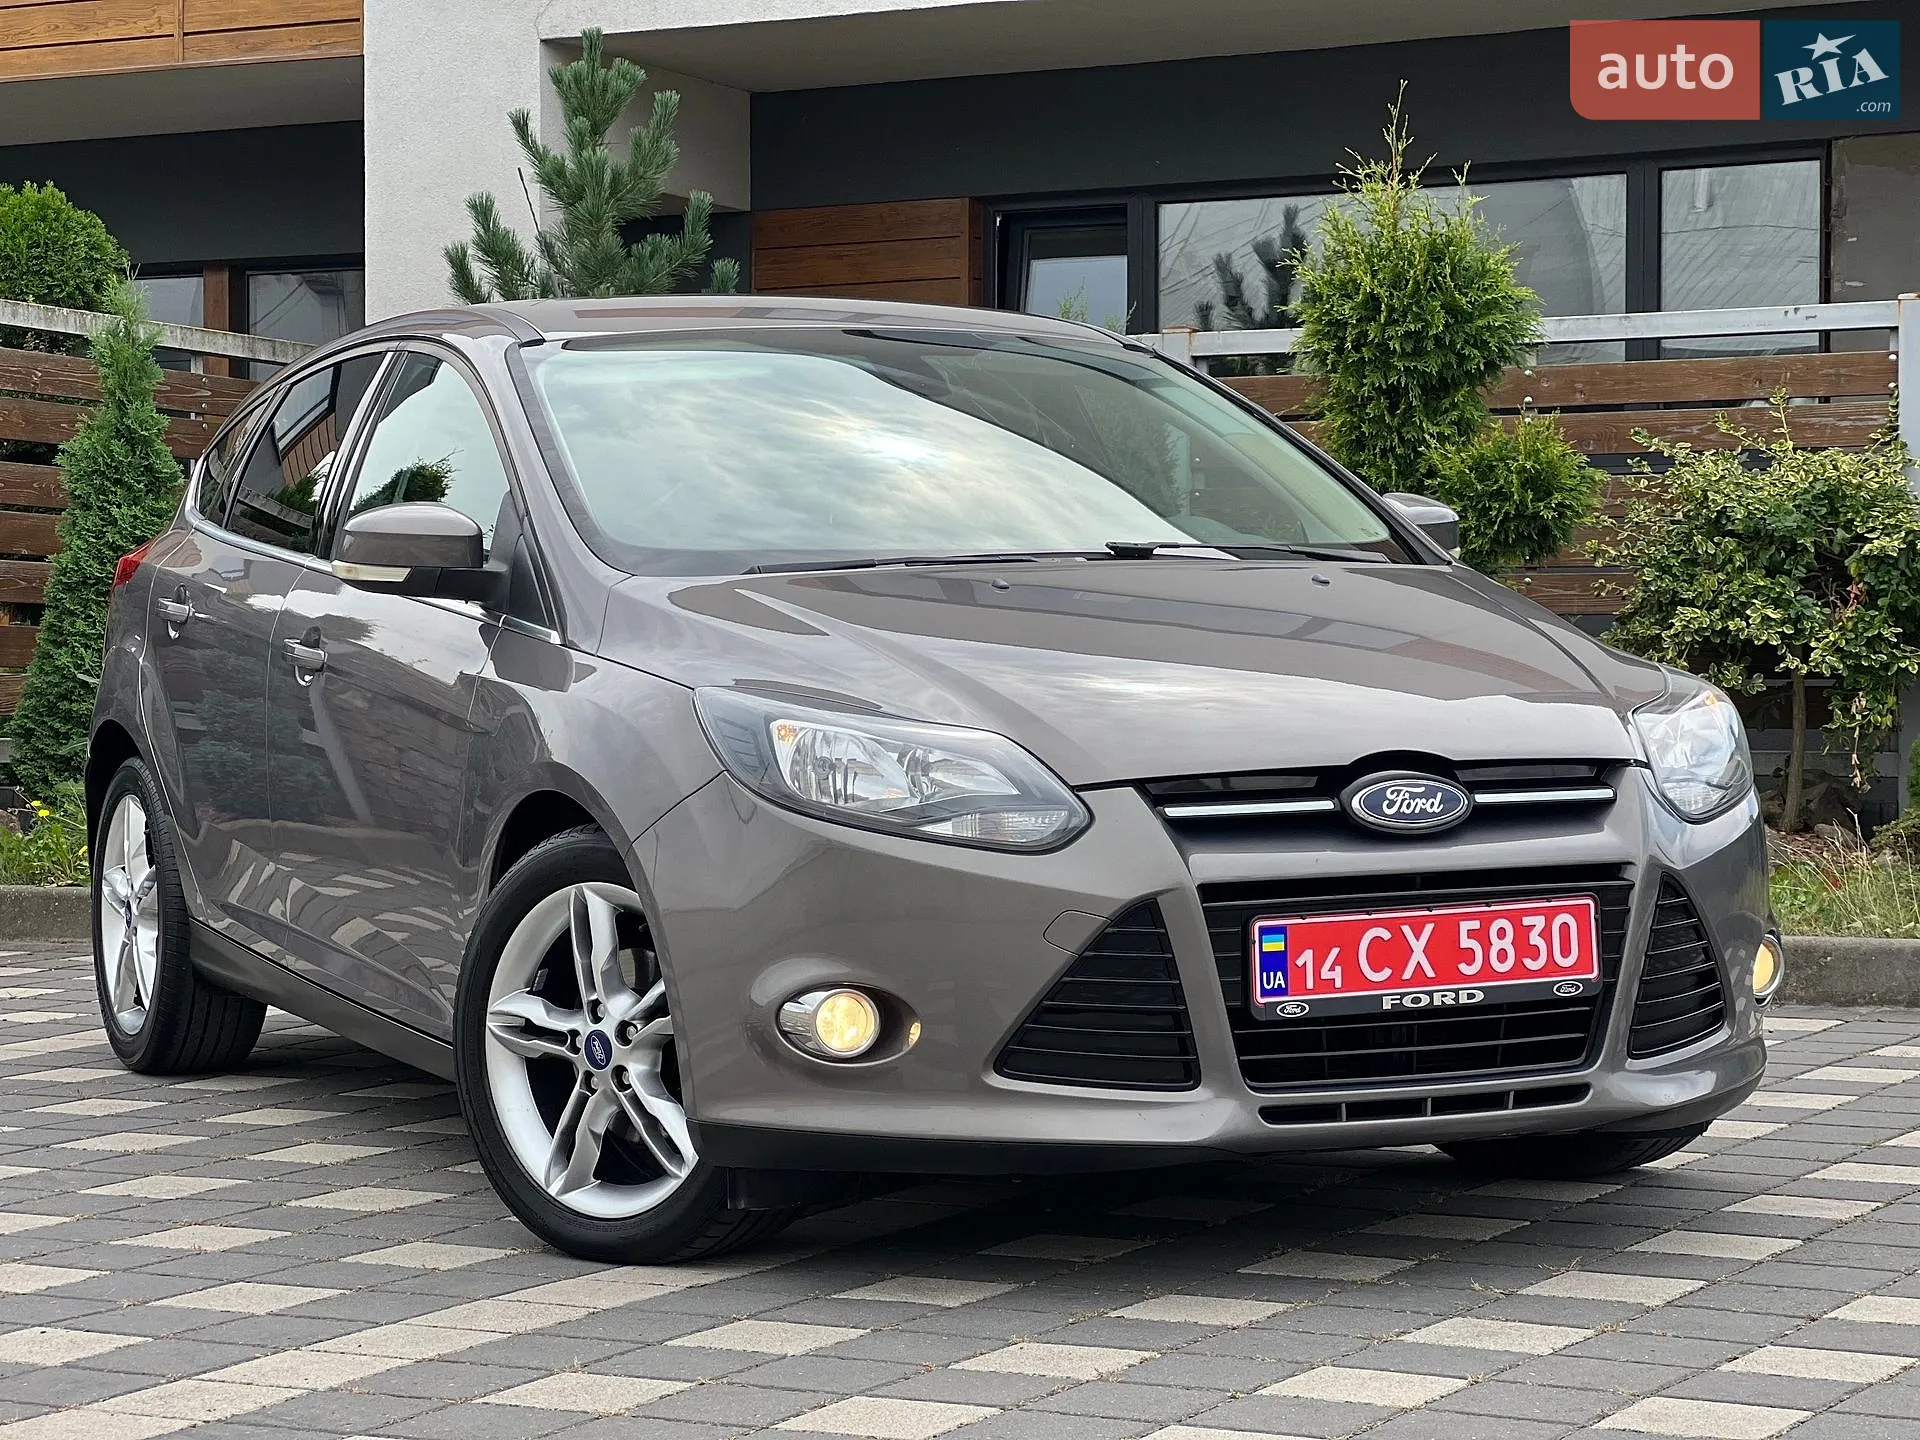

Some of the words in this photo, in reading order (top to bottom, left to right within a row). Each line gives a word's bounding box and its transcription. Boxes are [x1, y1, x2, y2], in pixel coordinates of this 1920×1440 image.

[1382, 786, 1444, 815] Ford
[1294, 947, 1343, 990] 14
[1357, 922, 1437, 983] CX
[1456, 912, 1579, 976] 5830
[1262, 970, 1286, 990] UA
[1382, 989, 1485, 1010] FORD
